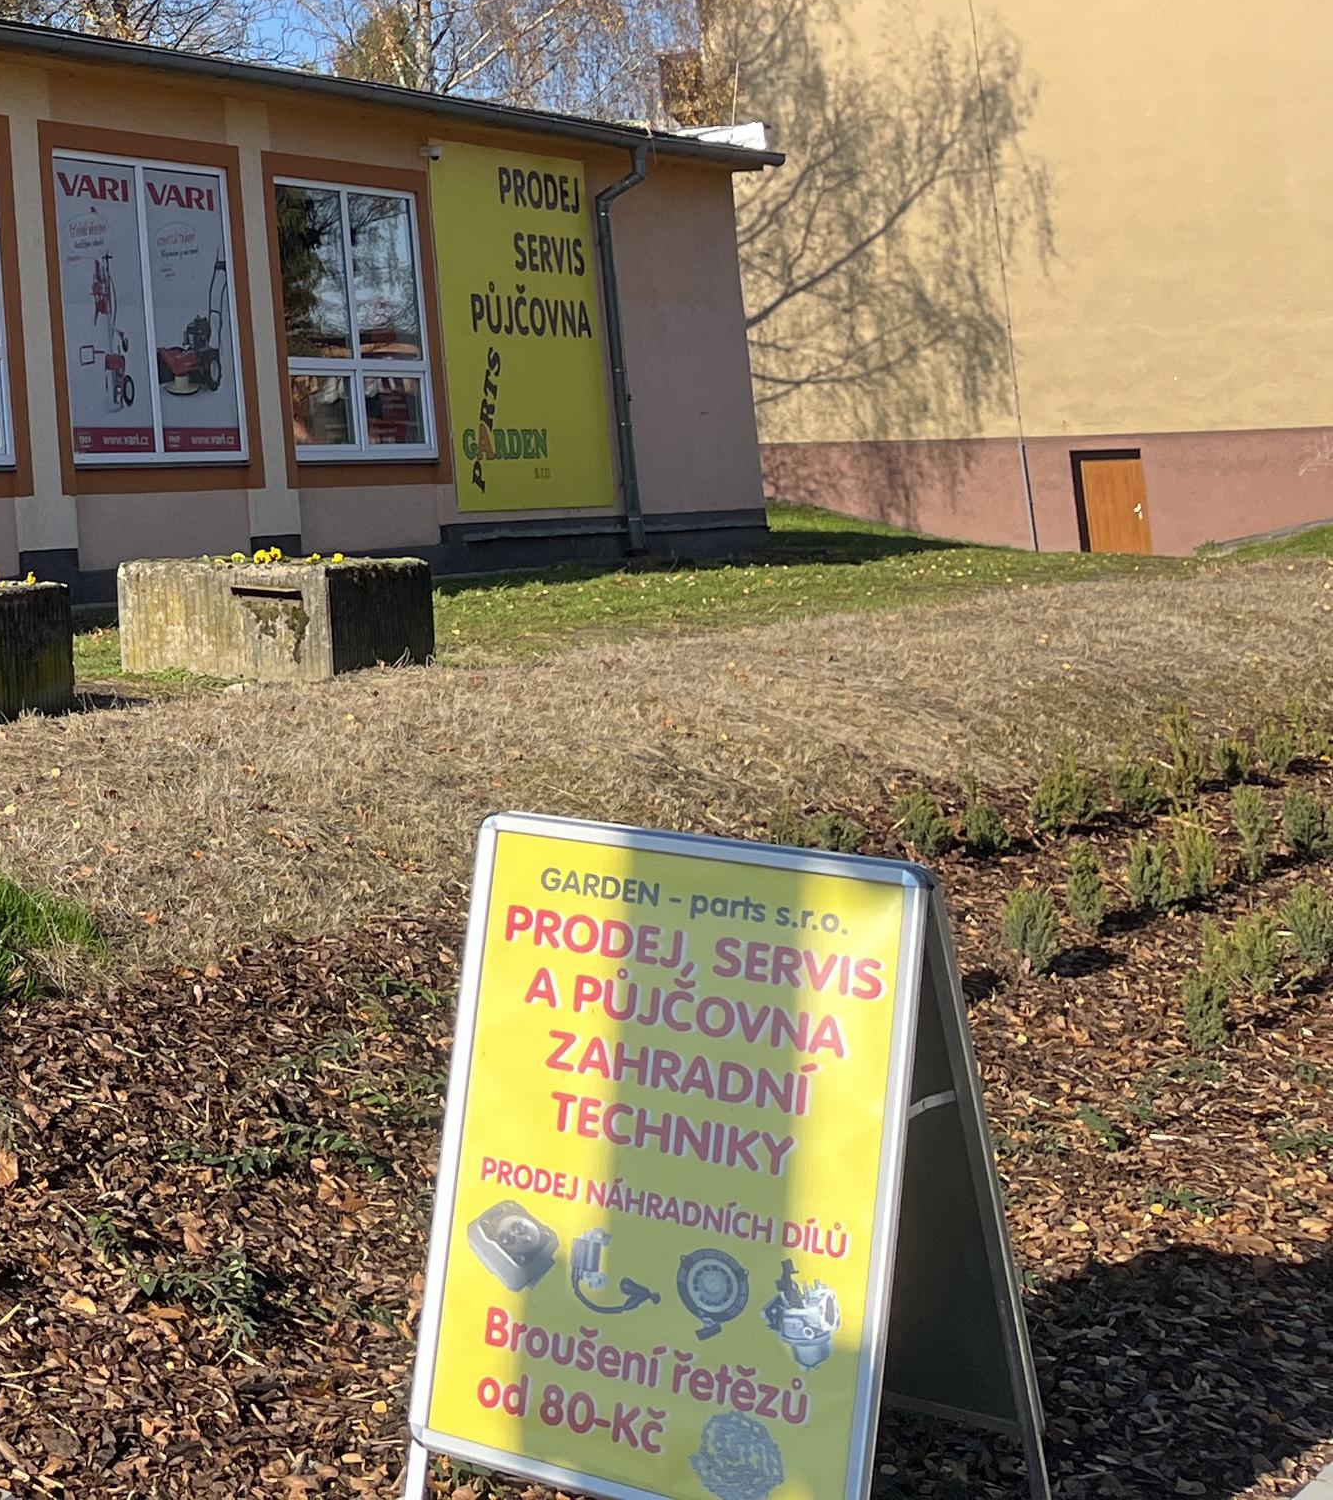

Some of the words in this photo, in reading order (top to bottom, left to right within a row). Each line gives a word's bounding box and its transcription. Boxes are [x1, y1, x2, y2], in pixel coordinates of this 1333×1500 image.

[57, 172, 129, 202] VARI
[146, 182, 214, 211] VARI
[498, 166, 580, 215] PRODEJ
[514, 232, 586, 277] SERVIS
[471, 281, 592, 339] PŮJČOVNA
[462, 424, 549, 461] GARDEN
[540, 867, 660, 907] GARDEN
[690, 890, 765, 923] parts
[775, 904, 848, 935] s.r.o.
[505, 904, 697, 975] PRODEJ,
[715, 937, 885, 1001] SERVIS
[525, 967, 556, 1009] A
[573, 967, 845, 1058] PŮJČOVNA
[544, 1030, 820, 1117] ZAHRADNÍ
[550, 1091, 795, 1176] TECHNIKY
[480, 1156, 578, 1202] PRODEJ
[585, 1177, 773, 1245] NÁHRADNÍCH
[781, 1214, 848, 1258] DÍLŮ
[484, 1305, 664, 1386] Broušení
[671, 1349, 808, 1425] řetězů
[476, 1376, 526, 1419] od
[539, 1390, 668, 1454] 80-Kč
